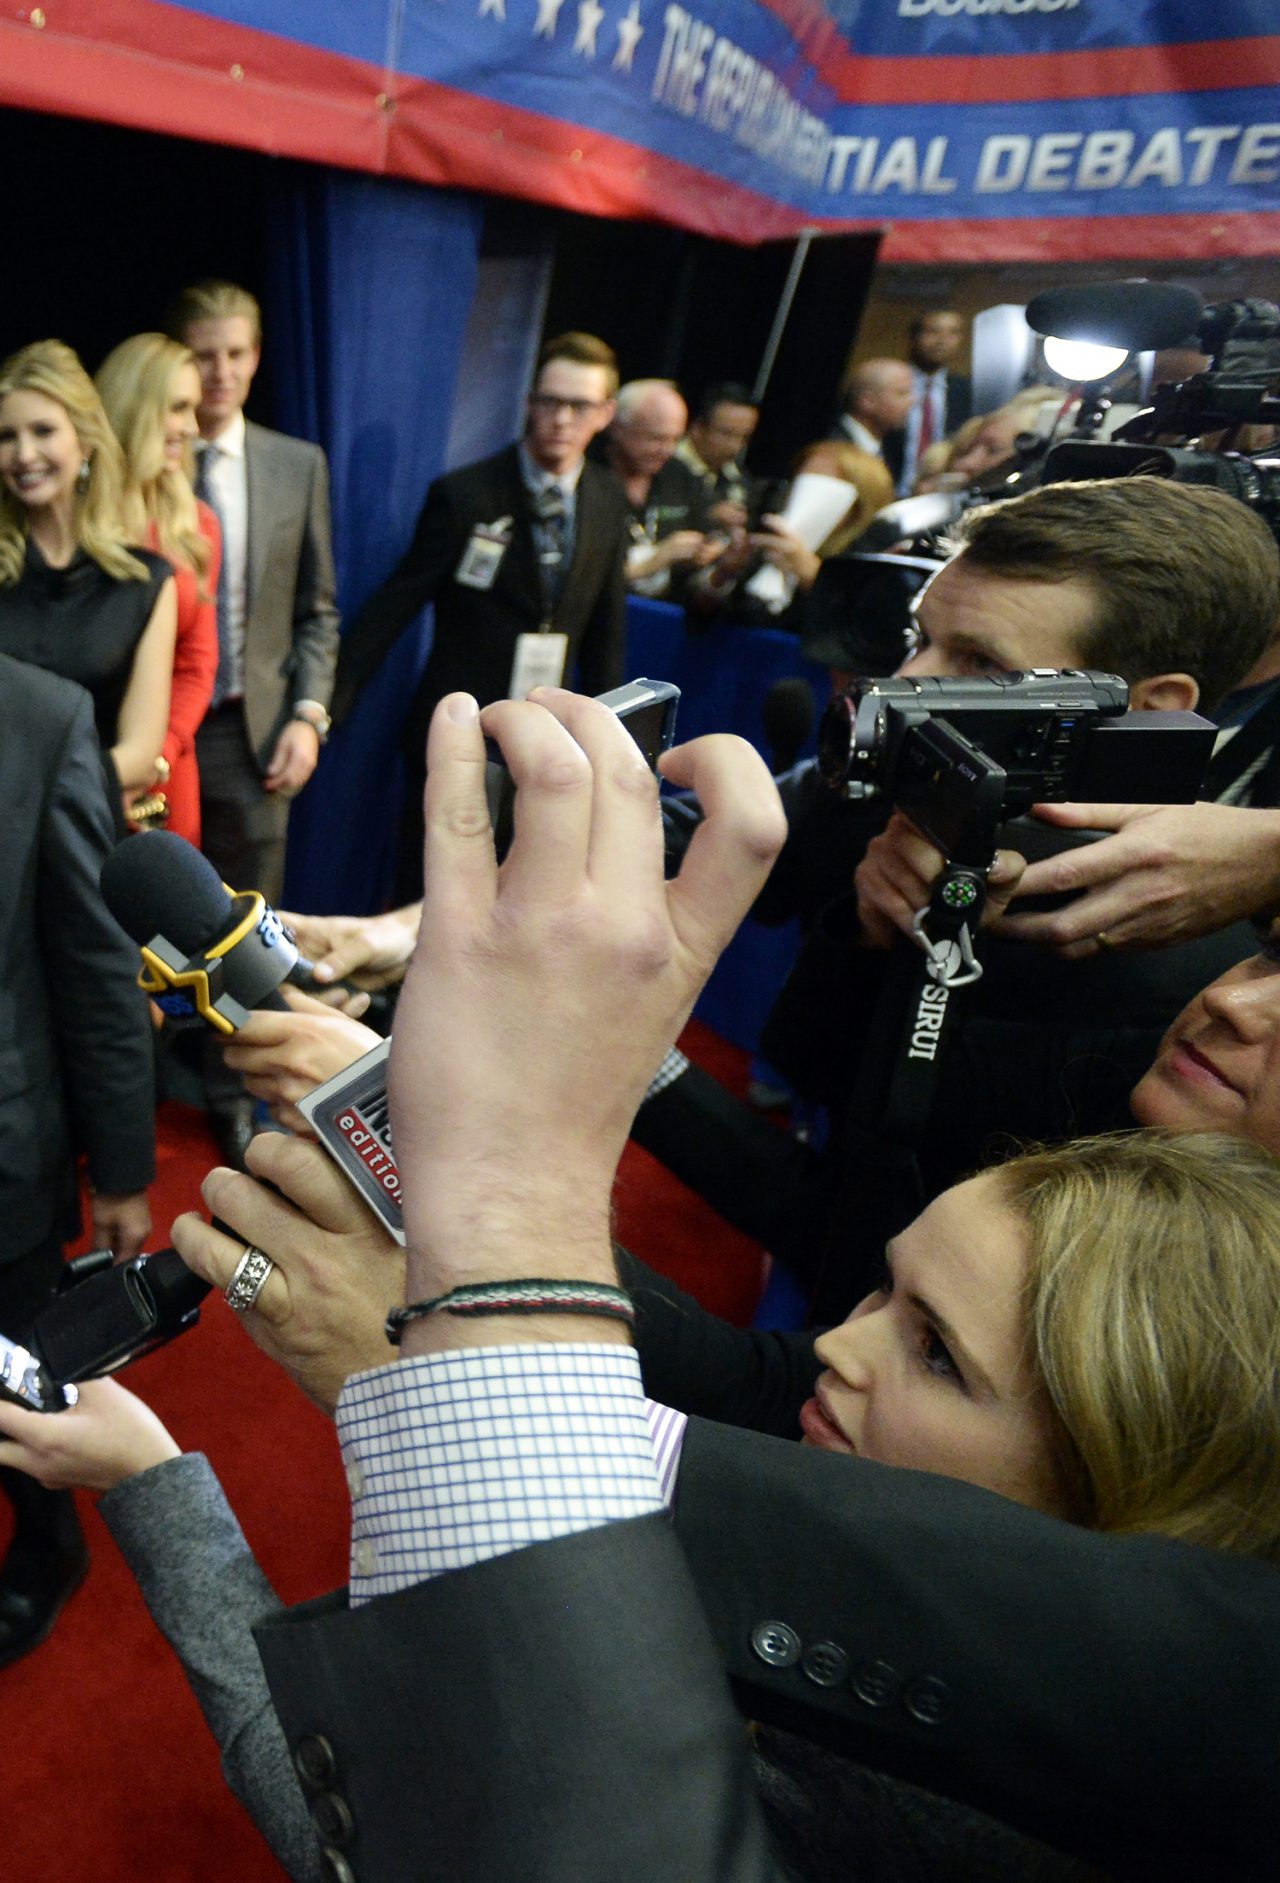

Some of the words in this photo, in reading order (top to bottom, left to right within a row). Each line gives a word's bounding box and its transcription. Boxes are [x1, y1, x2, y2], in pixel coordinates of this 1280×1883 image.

[650, 2, 716, 118] THE
[973, 122, 1280, 194] DEBATE
[908, 984, 949, 1061] SIRUI
